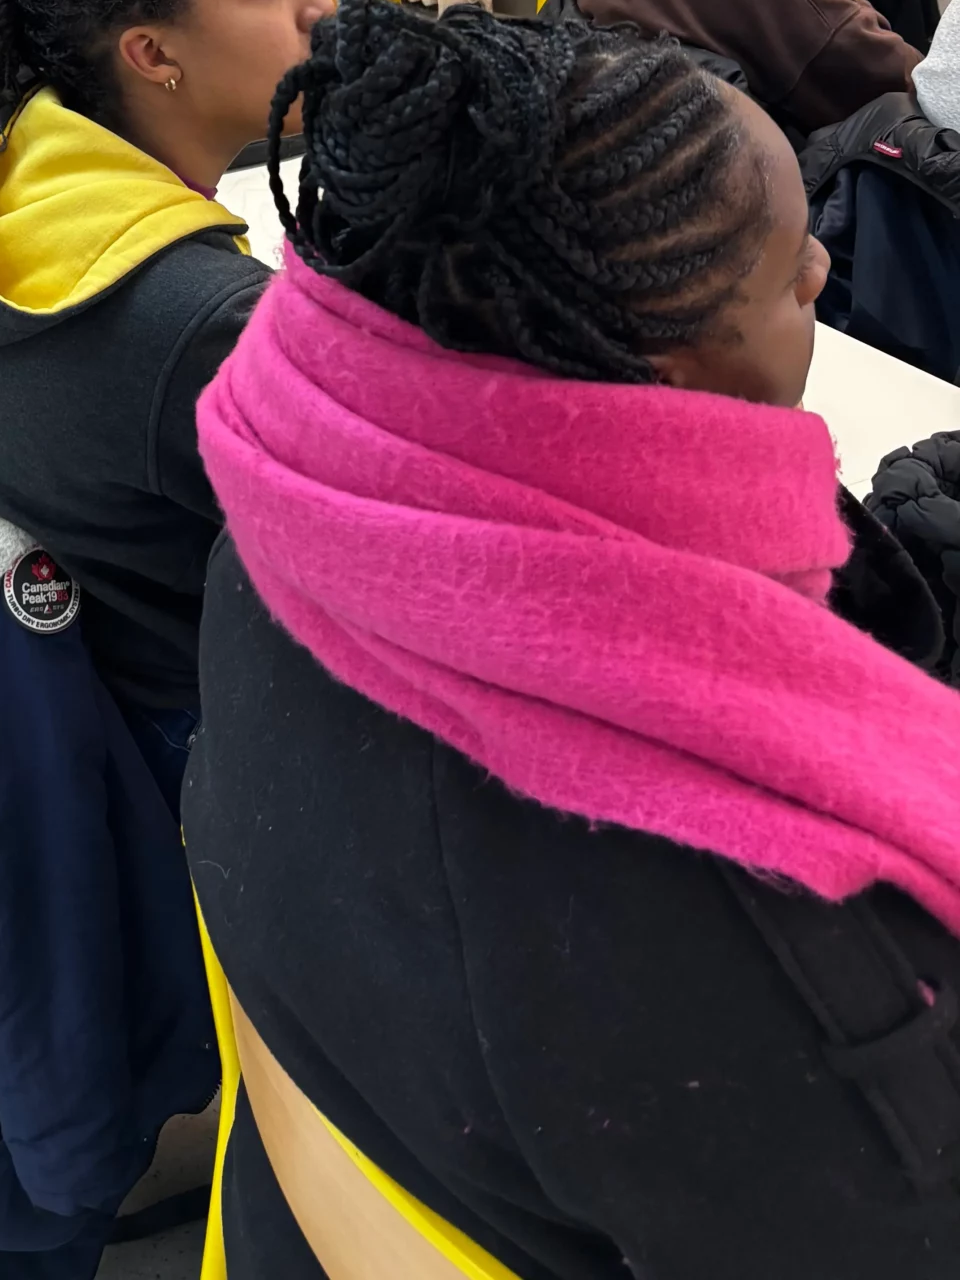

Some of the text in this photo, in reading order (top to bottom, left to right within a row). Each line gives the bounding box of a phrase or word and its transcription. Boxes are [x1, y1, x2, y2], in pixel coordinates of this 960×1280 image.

[7, 588, 79, 629] TURBO DRY ERGONOMIC SYSTEM
